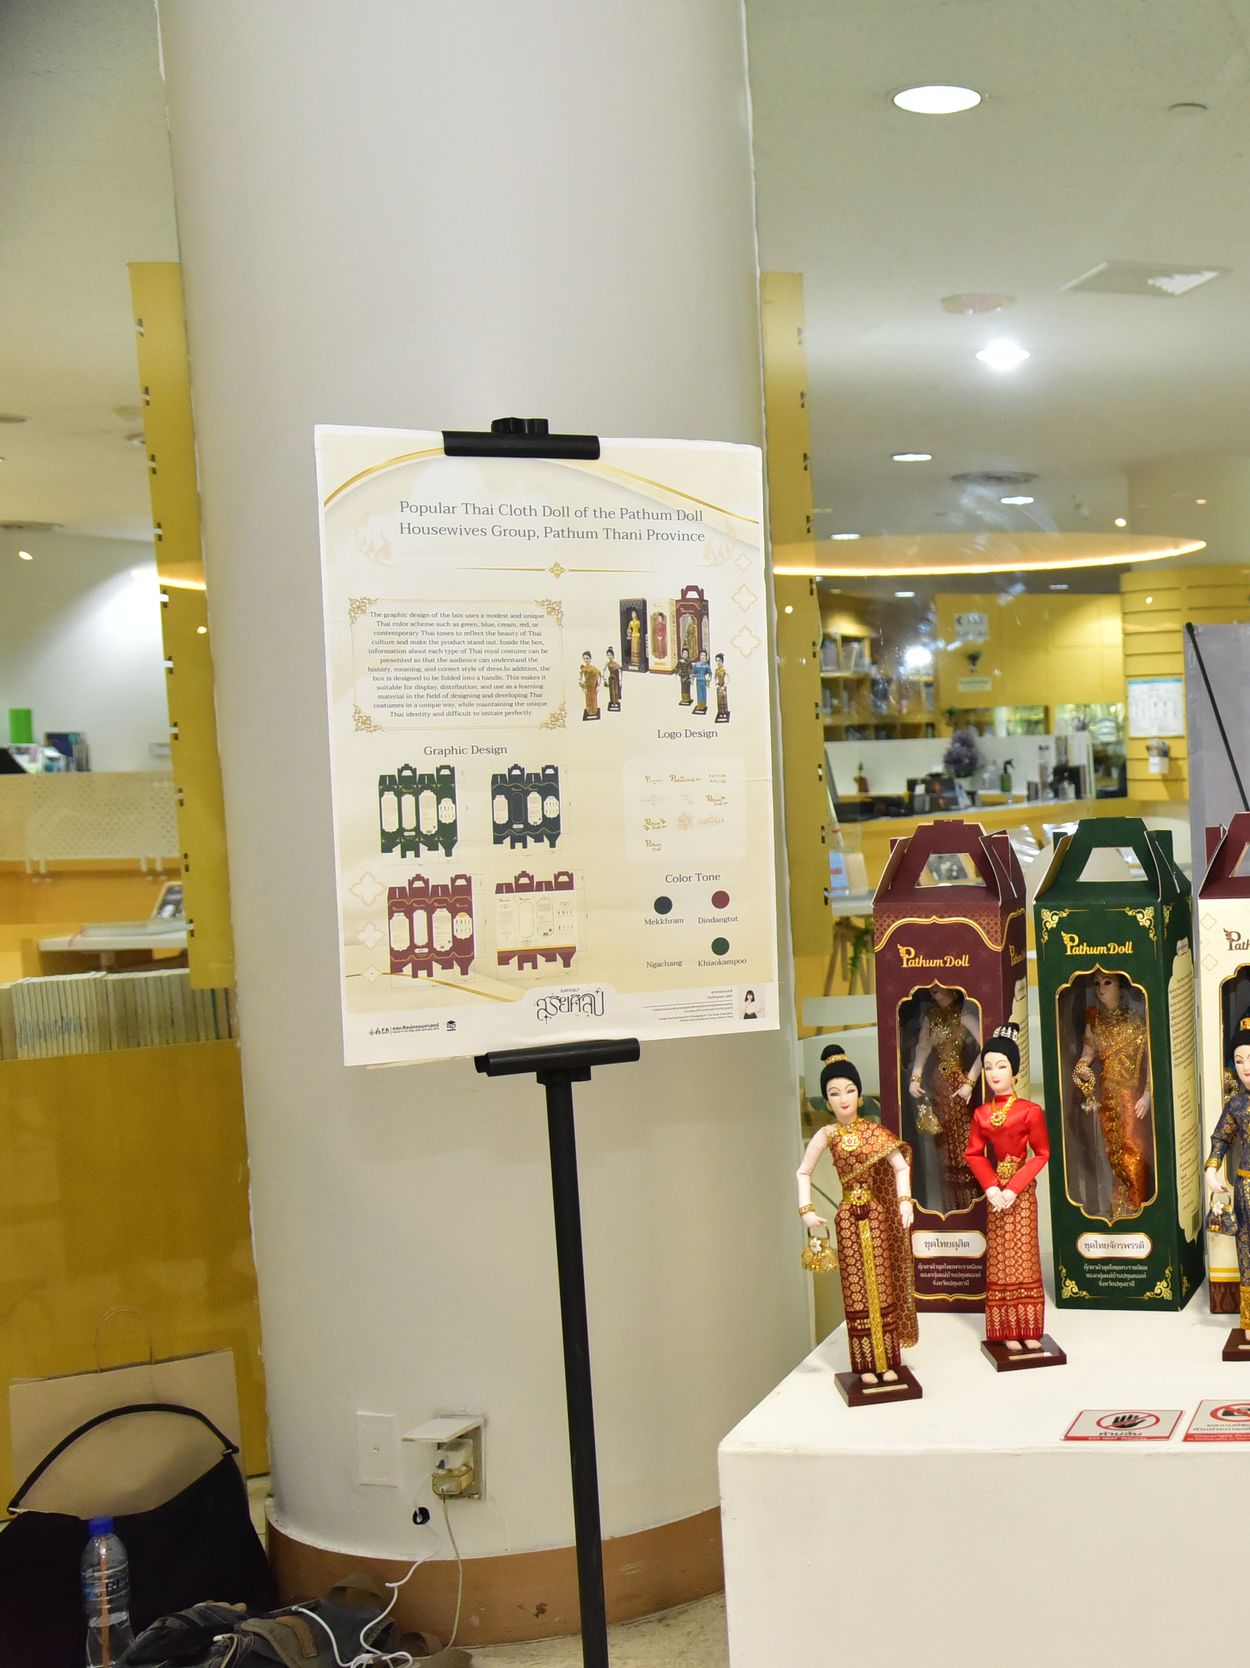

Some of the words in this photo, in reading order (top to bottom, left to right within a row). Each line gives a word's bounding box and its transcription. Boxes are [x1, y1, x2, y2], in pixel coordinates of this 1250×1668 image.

[400, 500, 458, 516] Popular
[461, 502, 494, 516] Thai
[498, 504, 538, 517] Cloth
[542, 505, 570, 518] Doll
[574, 506, 589, 518] of
[593, 507, 616, 519] the
[620, 507, 672, 520] Pathum
[677, 509, 703, 522] Doll
[400, 522, 487, 537] Housewives
[491, 524, 540, 541] Group,
[544, 526, 598, 540] Pathum
[603, 527, 642, 541] Thani
[647, 528, 705, 542] Province
[657, 728, 682, 740] Logo
[685, 727, 719, 740] Design
[423, 745, 468, 757] Graphic
[471, 744, 508, 756] Design
[665, 873, 693, 883] Color
[695, 872, 721, 882] Tone
[644, 917, 684, 926] Mekkhram
[697, 916, 738, 925] Dindangtut
[1061, 931, 1107, 955] Pathum
[1107, 941, 1134, 955] Doll
[897, 944, 943, 968] Pathum
[944, 954, 970, 968] Doll
[646, 960, 683, 969] Ngachang
